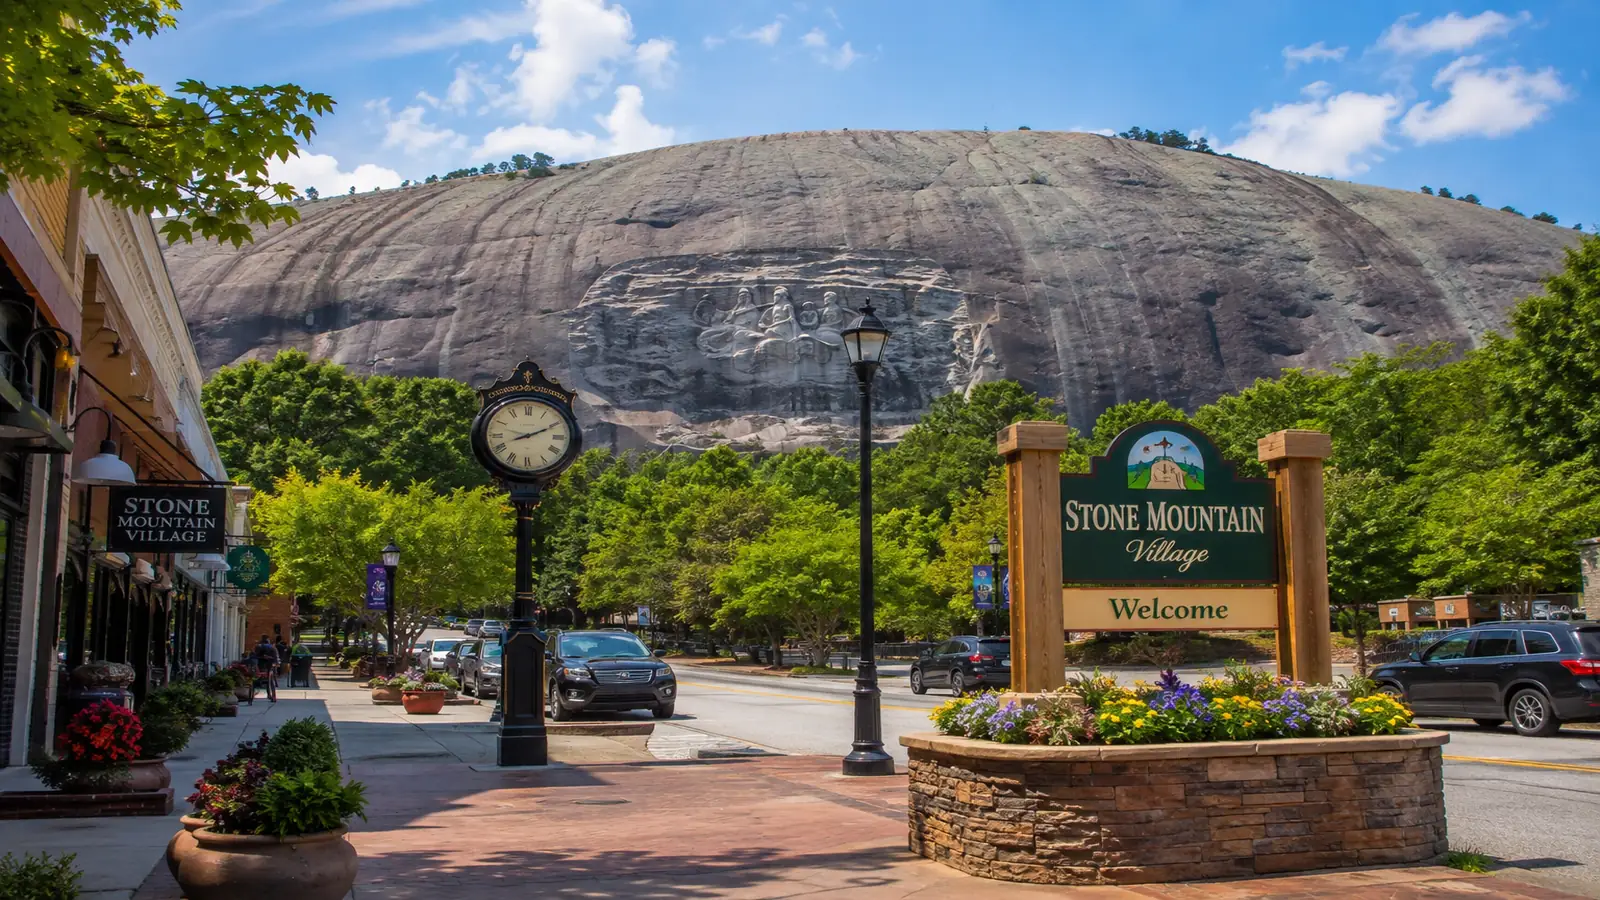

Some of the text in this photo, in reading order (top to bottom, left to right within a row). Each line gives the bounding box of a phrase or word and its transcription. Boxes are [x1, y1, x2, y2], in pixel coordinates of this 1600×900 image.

[124, 497, 210, 515] STONE
[117, 516, 216, 528] MOUNTAIN
[1065, 499, 1265, 534] STONE MOUNTAIN
[125, 530, 206, 542] VILLAGE
[1125, 537, 1209, 572] Village
[1108, 598, 1228, 620] Welcome
